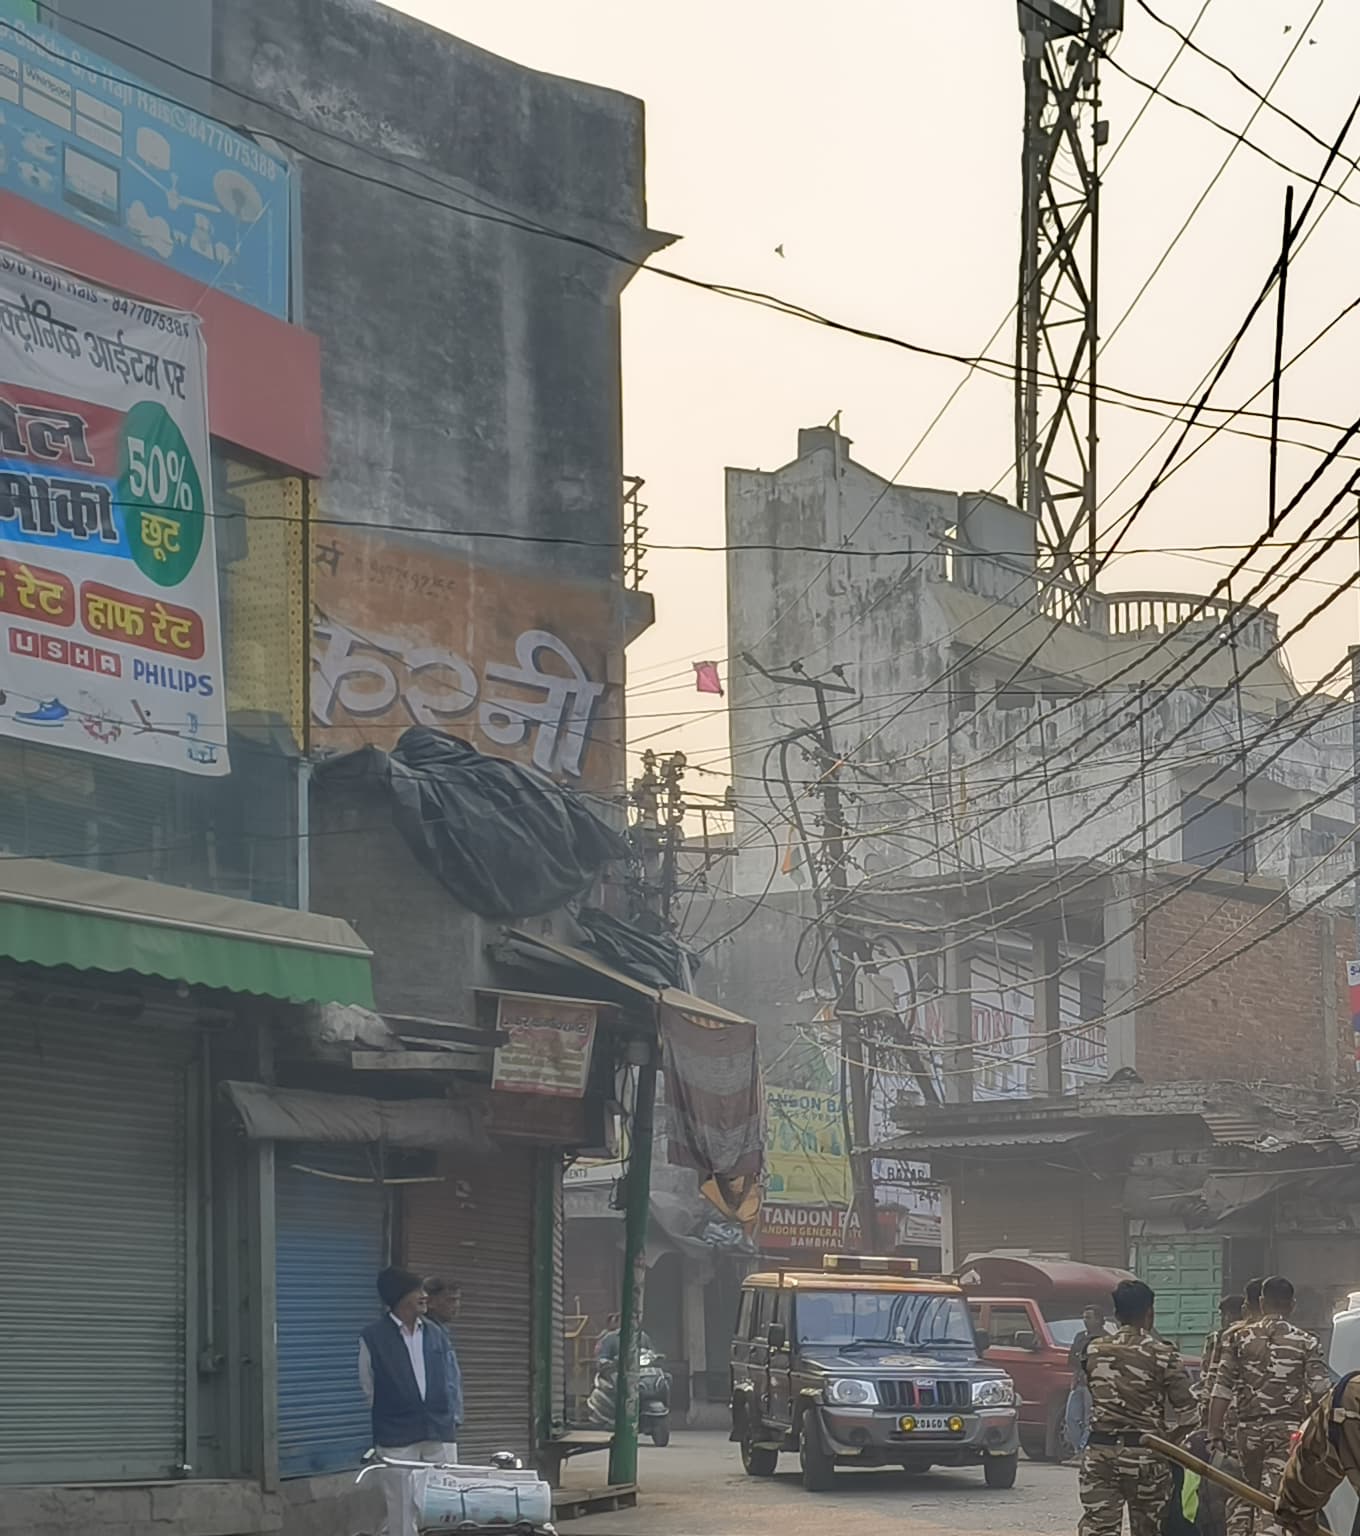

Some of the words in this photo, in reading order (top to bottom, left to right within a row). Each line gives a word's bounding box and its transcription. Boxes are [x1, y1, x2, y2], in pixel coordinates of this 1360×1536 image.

[127, 434, 194, 512] 50%
[140, 510, 182, 563] छूट
[150, 603, 193, 650] रेट
[14, 631, 118, 675] USHA
[133, 658, 214, 697] PHILIPS
[767, 1092, 821, 1112] ANDON
[761, 1225, 796, 1236] ANDON
[762, 1206, 832, 1227] TANDON
